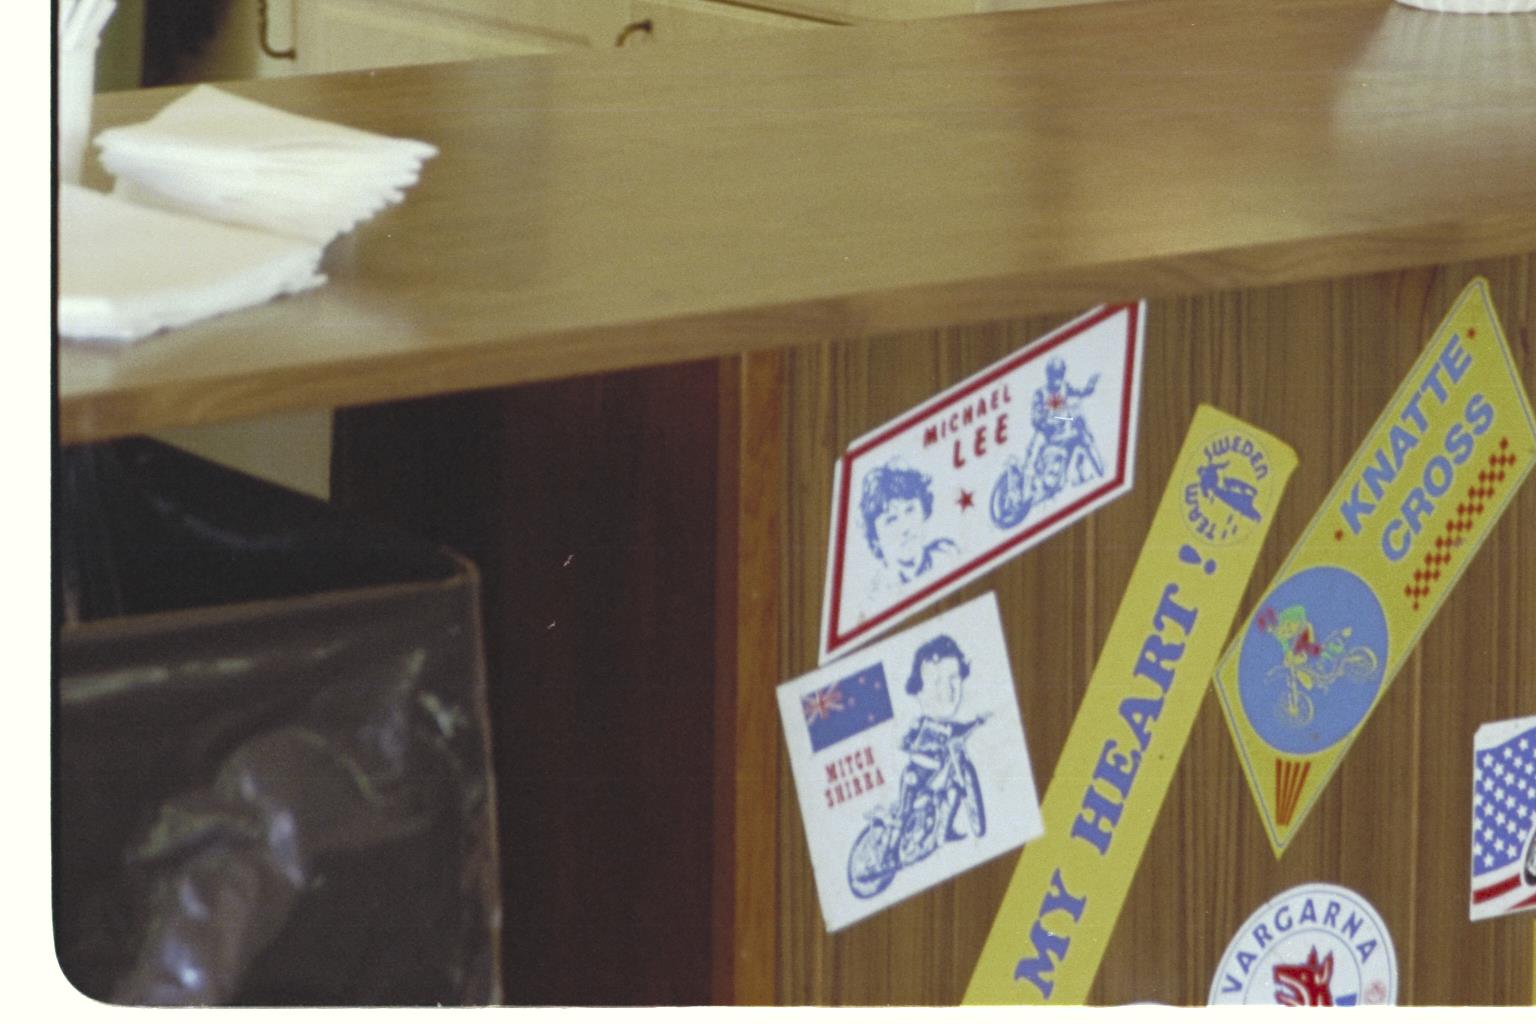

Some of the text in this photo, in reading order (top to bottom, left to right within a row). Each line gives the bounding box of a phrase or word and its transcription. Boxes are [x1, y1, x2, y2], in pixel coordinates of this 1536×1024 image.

[923, 383, 1011, 449] MICHAEL
[952, 413, 1008, 470] LEE
[1340, 333, 1472, 536] KNATTE
[1381, 393, 1494, 562] CROSS
[825, 745, 875, 784] MITCH
[1014, 867, 1087, 1001] MY
[1070, 582, 1198, 857] HEART
[1221, 898, 1378, 994] VARGARNA
